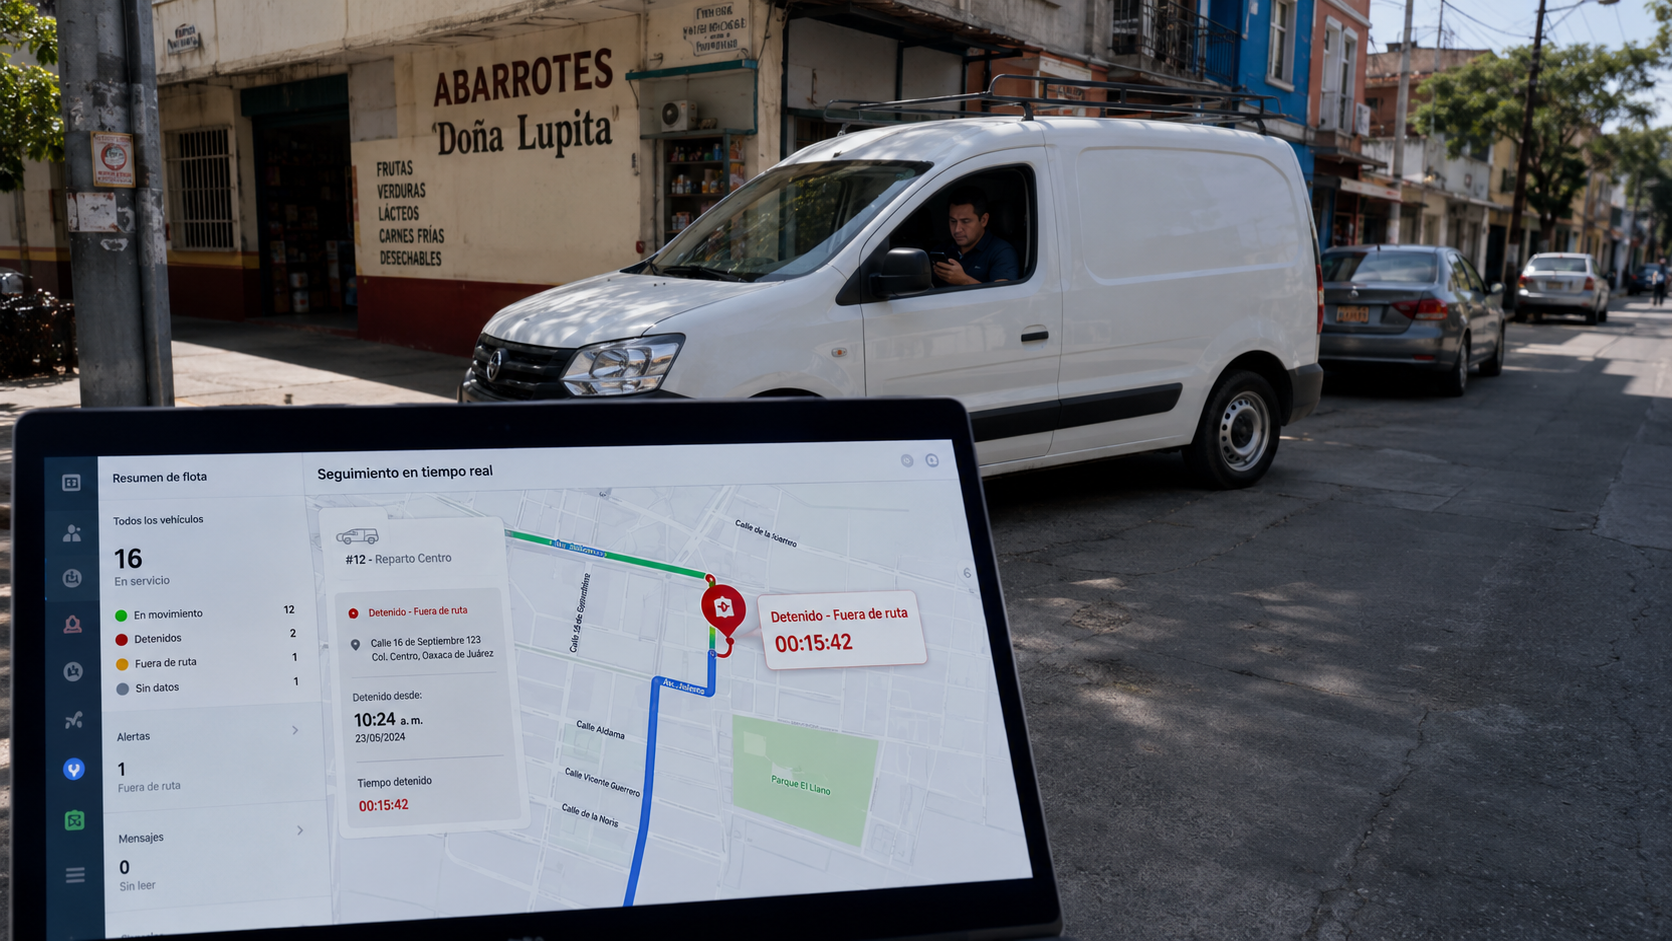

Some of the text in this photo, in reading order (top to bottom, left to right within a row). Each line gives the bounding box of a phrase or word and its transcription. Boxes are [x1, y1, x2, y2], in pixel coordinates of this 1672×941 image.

[433, 46, 614, 108] ABARROTES
[377, 160, 413, 177] FRUTAS
[377, 182, 426, 199] VERDURAS
[378, 203, 419, 221] LÁCTEOS
[379, 225, 445, 244] CARNES FRÍAS
[380, 250, 442, 266] DESECHABLES
[112, 471, 208, 484] Resumen de flota
[317, 464, 493, 483] Seguimiento en tiempo real
[113, 514, 204, 526] Todos los vehículos
[114, 547, 143, 569] 16
[345, 554, 366, 565] #12
[375, 554, 416, 567] Reparto
[417, 552, 452, 564] Centro
[114, 575, 170, 587] En servicio
[134, 608, 203, 620] En movimiento
[283, 604, 295, 614] 12
[368, 607, 407, 618] Detenido
[413, 606, 436, 617] Fuera
[438, 605, 450, 616] de
[451, 606, 468, 615] ruta
[770, 609, 824, 623] Detenido
[832, 608, 866, 621] Fuera
[868, 607, 883, 620] de
[884, 607, 909, 619] ruta
[134, 633, 182, 644] Detenidos
[289, 628, 297, 638] 2
[370, 635, 482, 648] Calle 16 de Septiembre 123
[775, 632, 853, 653] 00:15:42
[292, 652, 297, 662] 1
[371, 649, 494, 662] Col. Centro, Oaxaca de Juárez
[135, 657, 197, 669] Fuera de ruta
[293, 676, 299, 686] 1
[135, 683, 180, 693] Sin datos
[352, 690, 423, 703] Detenido desde:
[354, 711, 396, 728] 10:24
[576, 720, 625, 740] Calle Aldama
[116, 732, 151, 742] Alertas
[355, 732, 406, 744] 23/05/2024
[117, 761, 125, 777] 1
[117, 781, 181, 793] Fuera de ruta
[357, 775, 433, 789] Tiempo detenido
[565, 767, 583, 780] Calle
[610, 782, 640, 798] Guerrero
[771, 774, 831, 796] Parque El Llano
[358, 798, 409, 812] 00:15:42
[562, 803, 580, 816] Calle
[580, 809, 591, 819] de
[592, 812, 598, 822] la
[118, 832, 164, 845] Mensajes
[119, 859, 130, 875] 0
[119, 880, 156, 892] Sin leer
